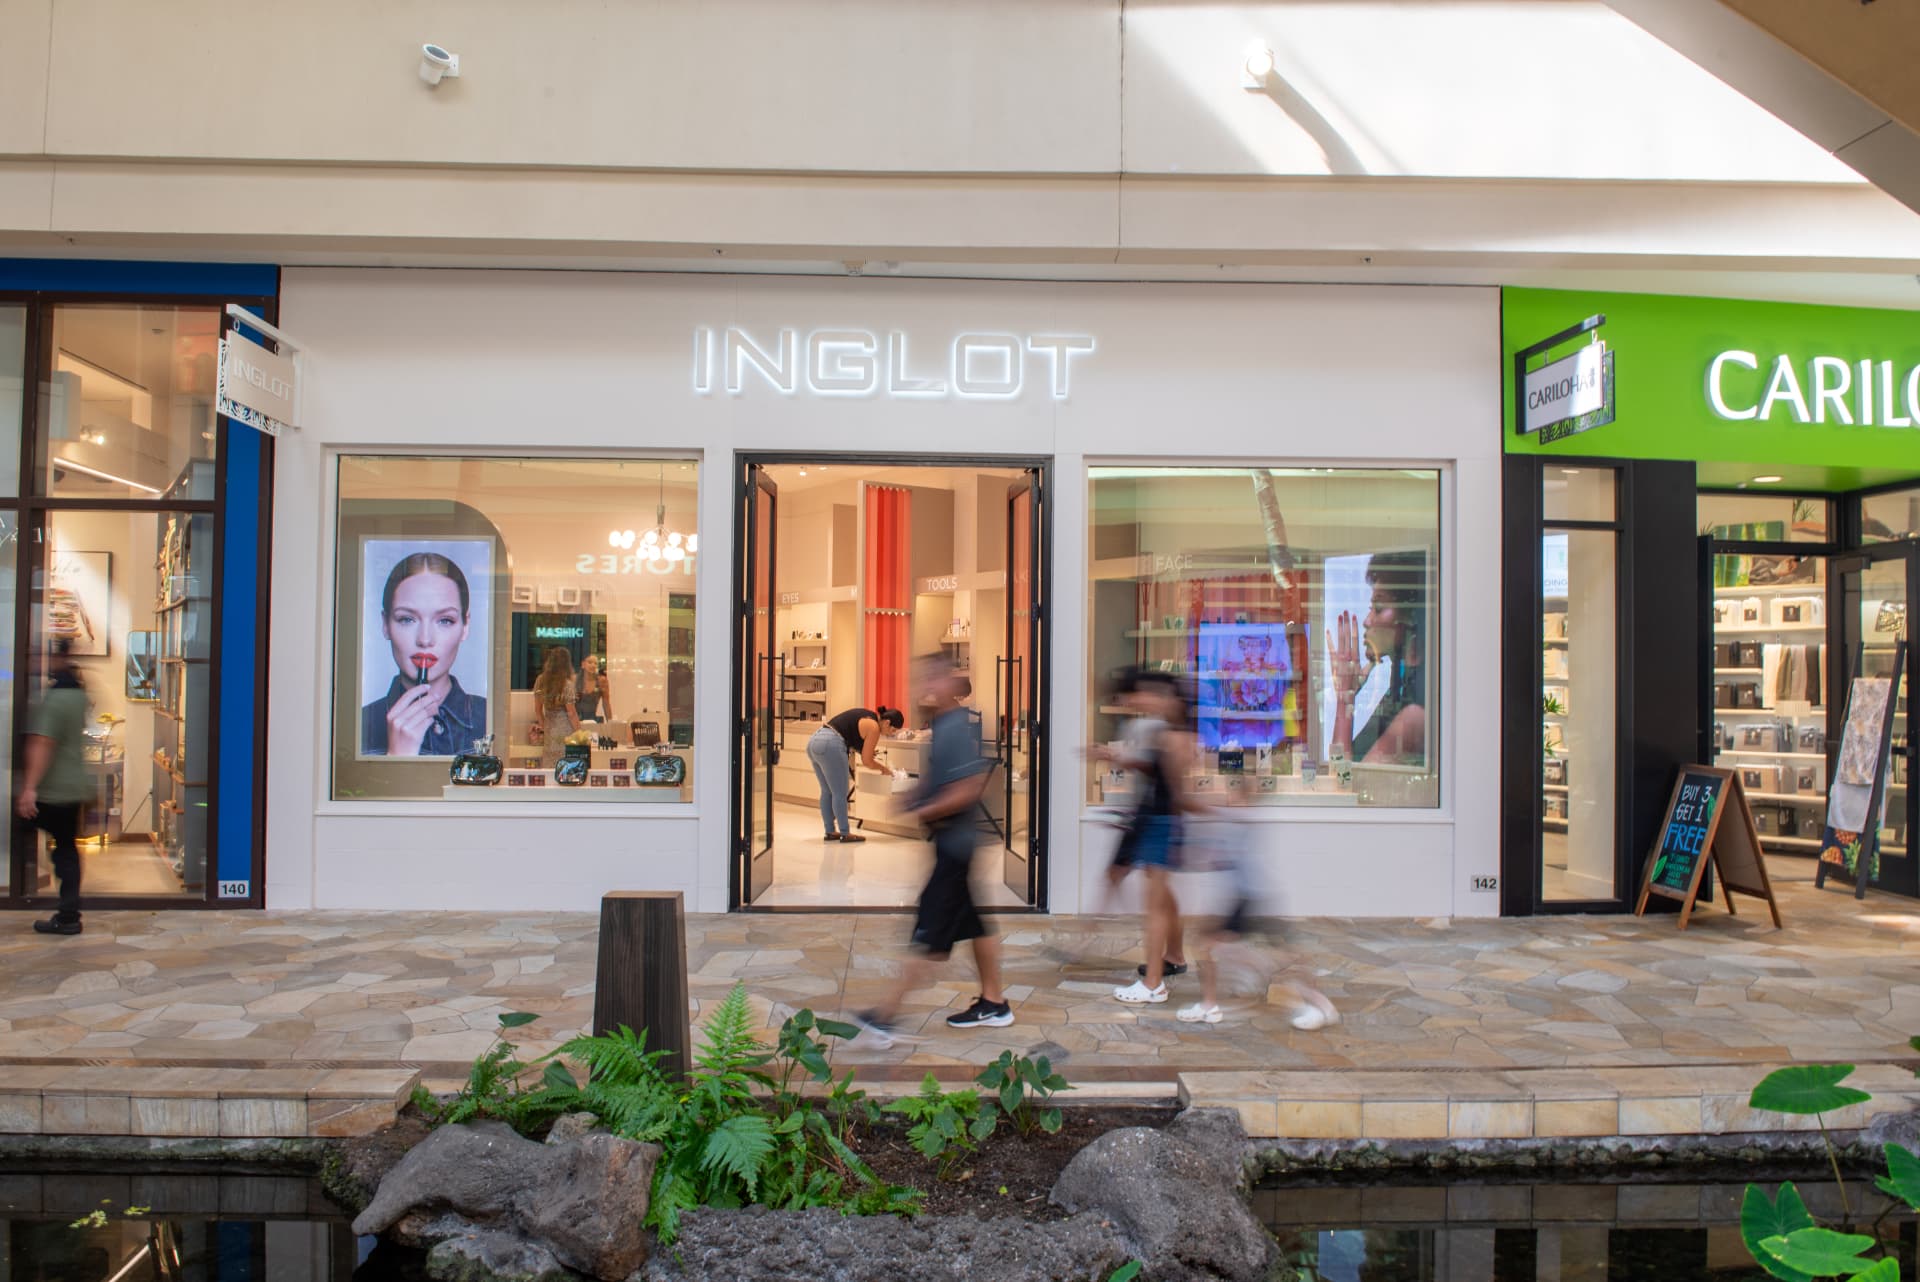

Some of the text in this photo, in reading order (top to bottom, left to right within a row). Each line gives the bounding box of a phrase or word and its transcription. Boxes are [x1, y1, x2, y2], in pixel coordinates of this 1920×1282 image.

[694, 328, 1095, 398] INGLOT
[233, 356, 294, 401] INGLOT
[1528, 374, 1589, 410] CARILOHA
[1705, 350, 1920, 429] CARIL
[1155, 554, 1193, 571] FACE
[927, 576, 958, 591] TOOLS
[512, 584, 601, 608] GLOT
[782, 592, 799, 604] EYES
[1681, 784, 1712, 803] BUY 3
[1675, 803, 1704, 822] GET 1
[1664, 823, 1708, 855] FREE
[222, 883, 246, 895] 140
[1474, 877, 1496, 889] 142
